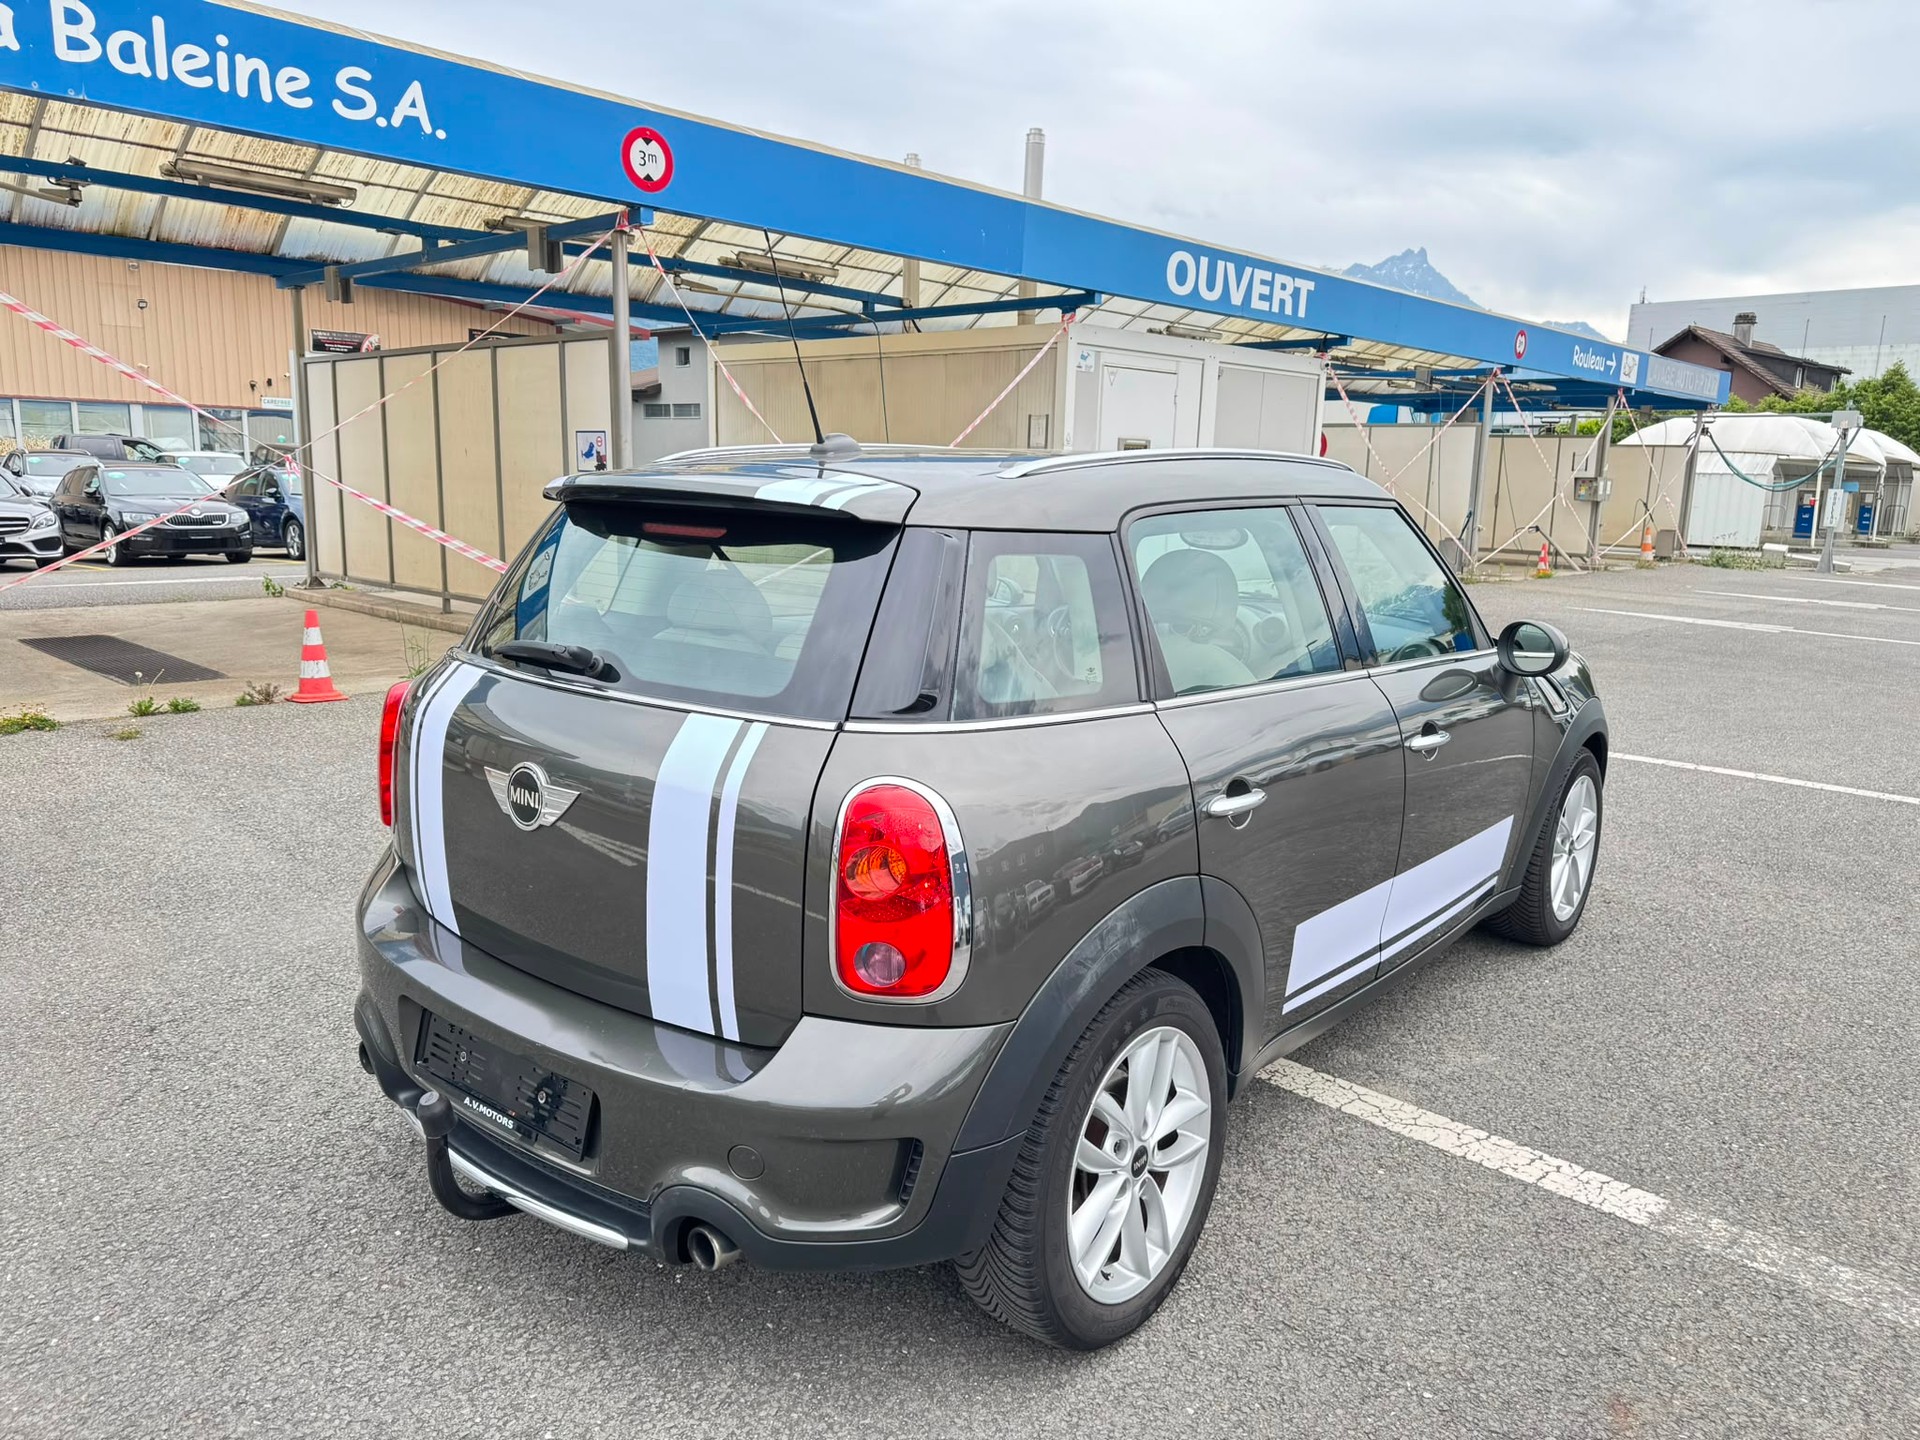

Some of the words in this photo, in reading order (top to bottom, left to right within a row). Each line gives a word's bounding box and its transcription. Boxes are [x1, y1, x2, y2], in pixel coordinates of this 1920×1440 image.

[50, 0, 313, 108] Baleine
[332, 66, 447, 140] S.A.
[1166, 250, 1315, 318] OUVERT
[1572, 345, 1606, 372] Rouleau
[510, 785, 539, 809] MINI
